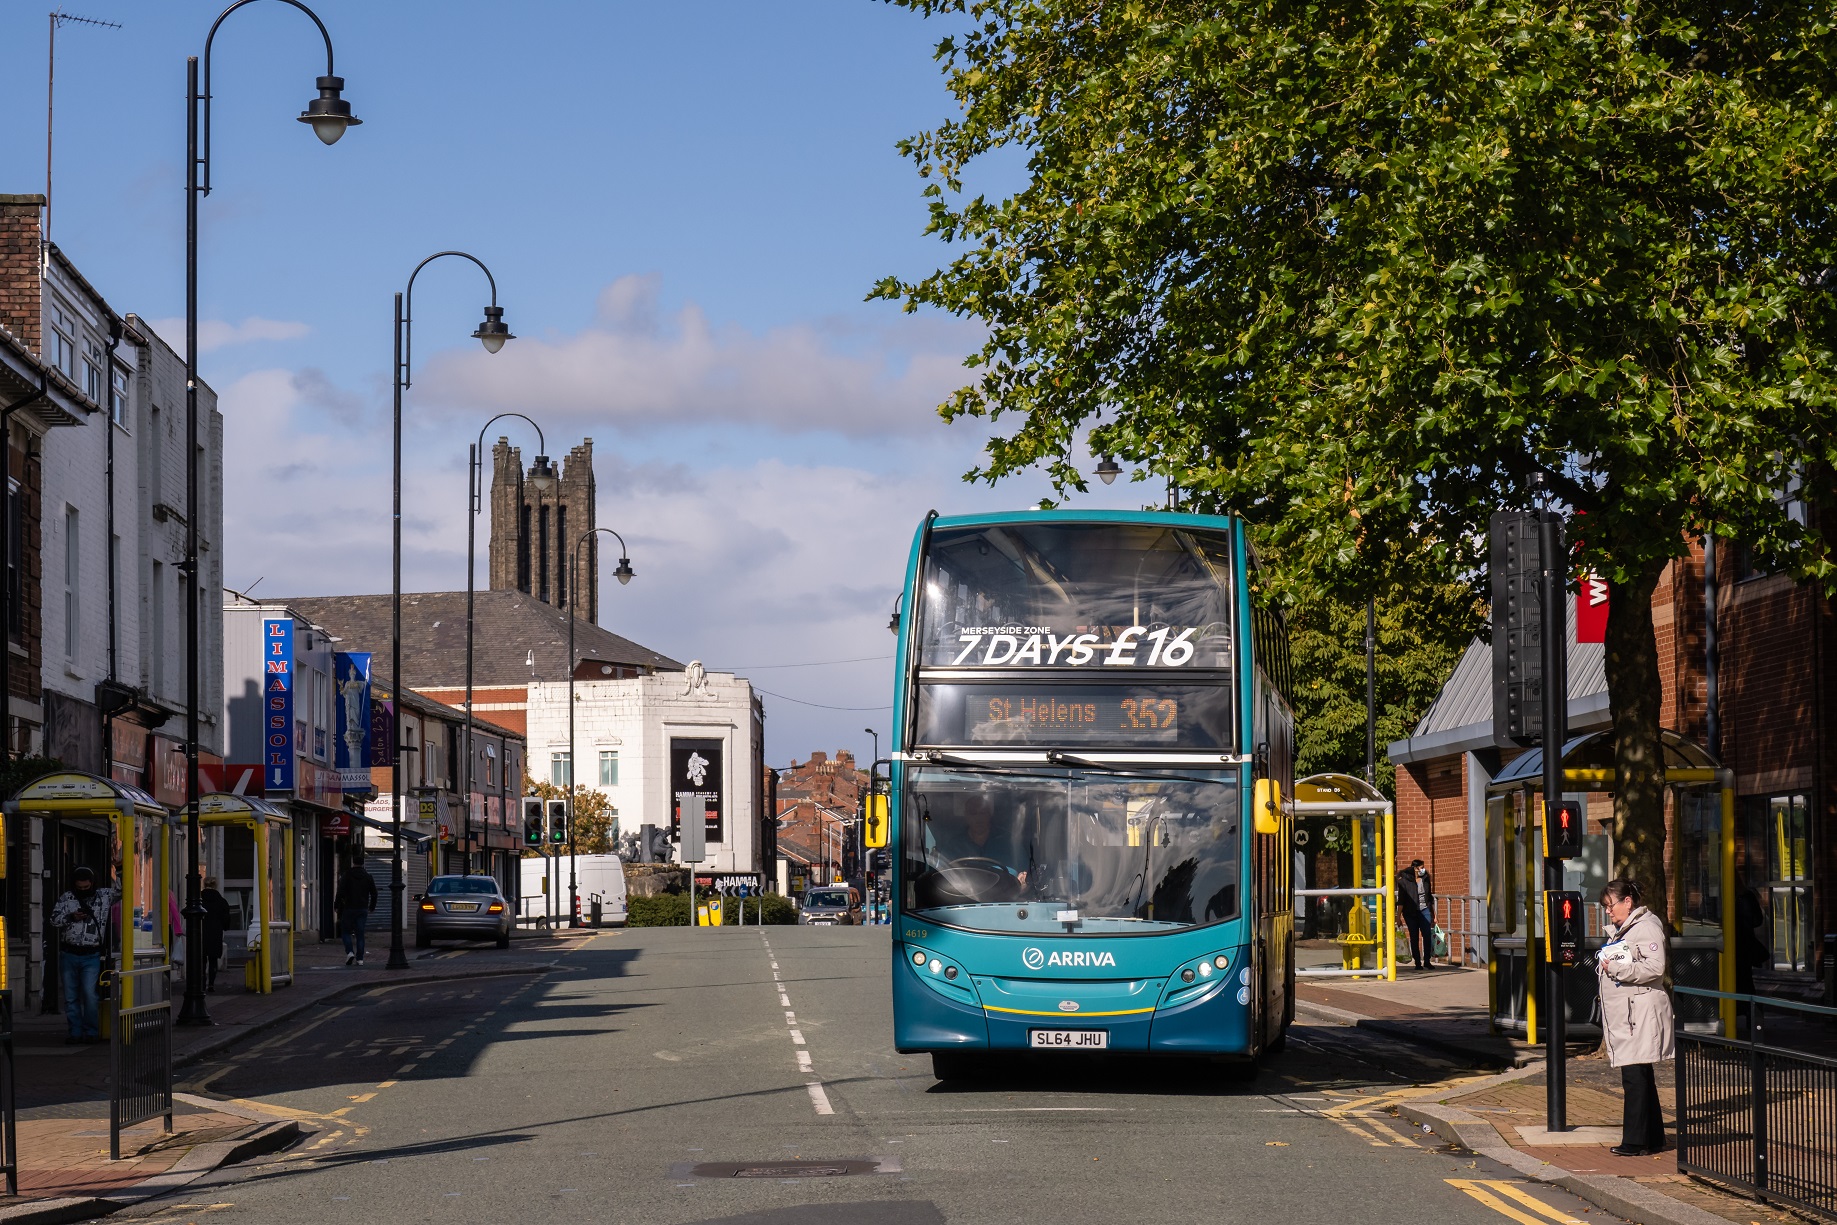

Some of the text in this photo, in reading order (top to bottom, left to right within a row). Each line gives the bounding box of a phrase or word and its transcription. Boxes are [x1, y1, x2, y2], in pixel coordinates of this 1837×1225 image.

[961, 626, 1051, 635] MERSEYSIDE ZONE
[952, 626, 1196, 666] 7 DAYS £16
[267, 624, 287, 765] LIMASSOL
[988, 698, 1012, 722] St
[1020, 698, 1096, 722] Helens
[371, 736, 386, 766] Salon
[420, 802, 434, 813] D3
[723, 876, 758, 886] HAMMA
[906, 930, 928, 939] 4619
[1048, 951, 1116, 967] ARRIVA
[1037, 1032, 1101, 1046] SL64 JHU
